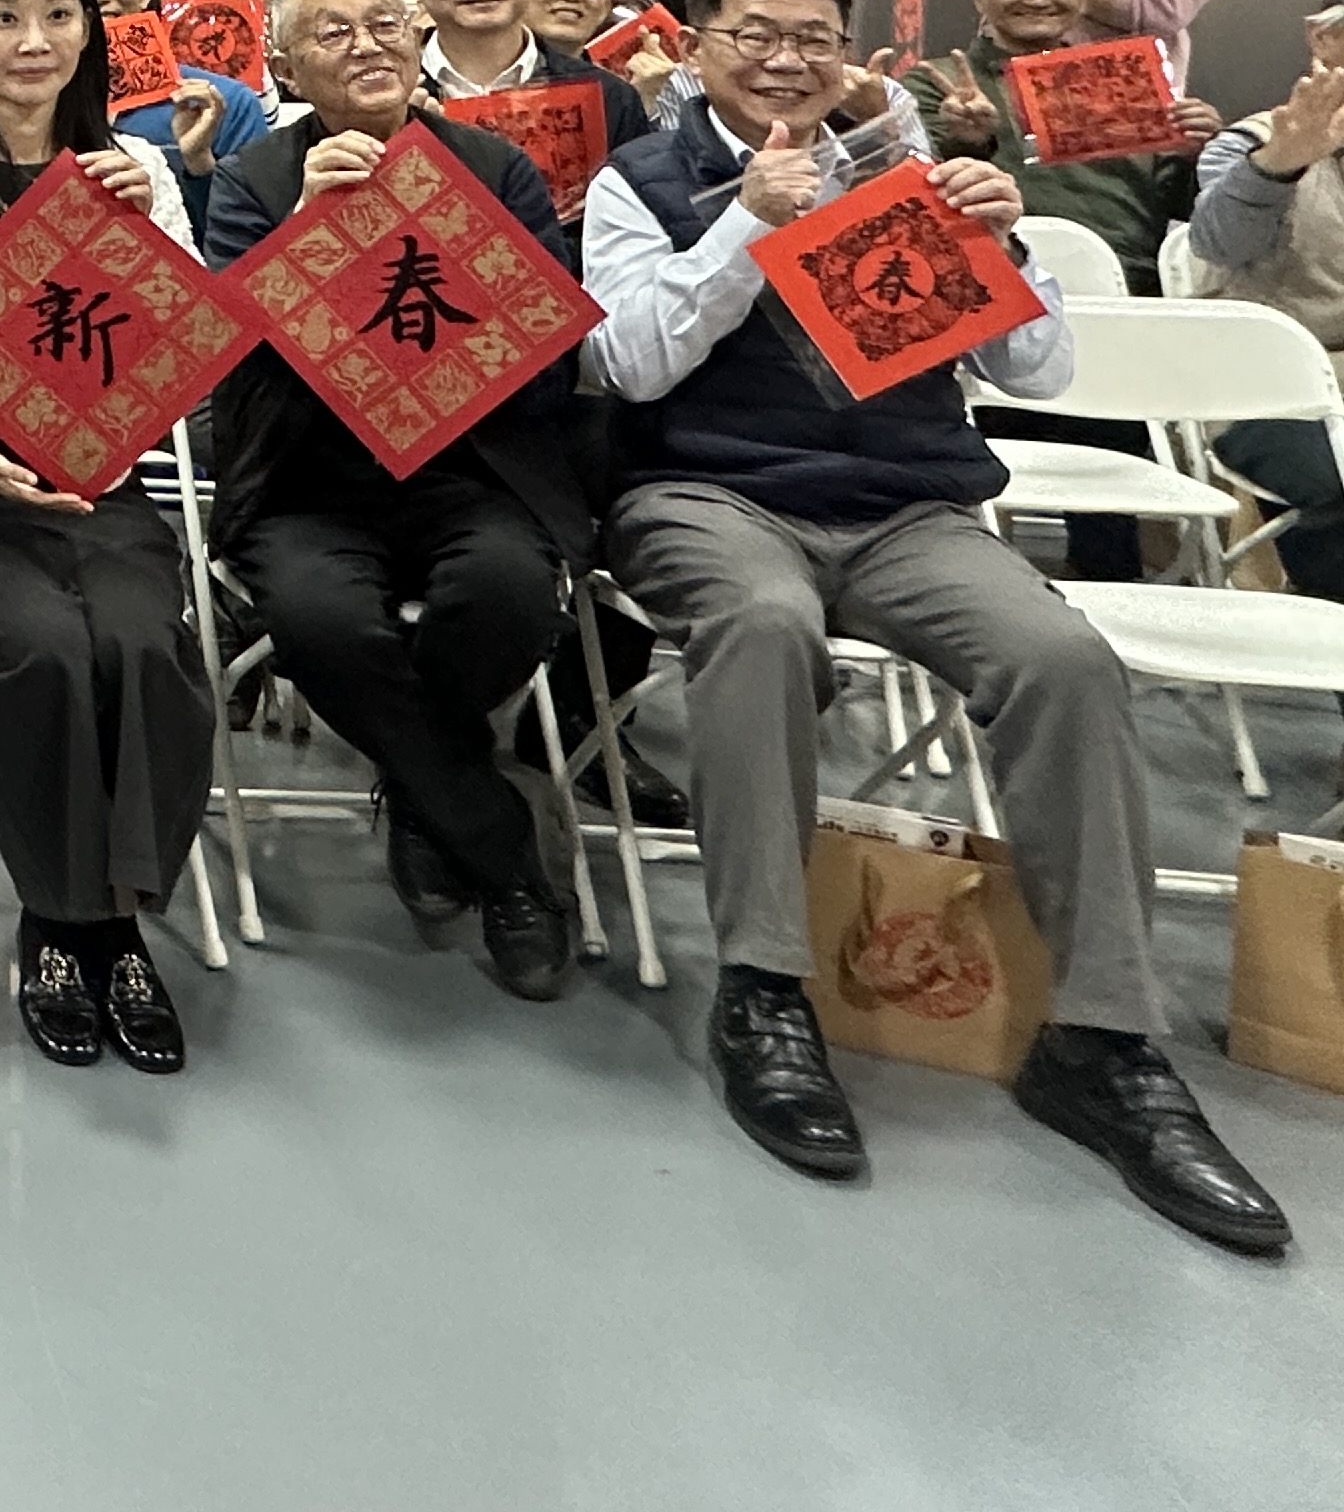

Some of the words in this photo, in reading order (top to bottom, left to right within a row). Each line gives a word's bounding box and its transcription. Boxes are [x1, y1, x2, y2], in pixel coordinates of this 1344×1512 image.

[359, 234, 479, 353] 春
[859, 250, 928, 306] 春
[27, 279, 132, 388] 新
